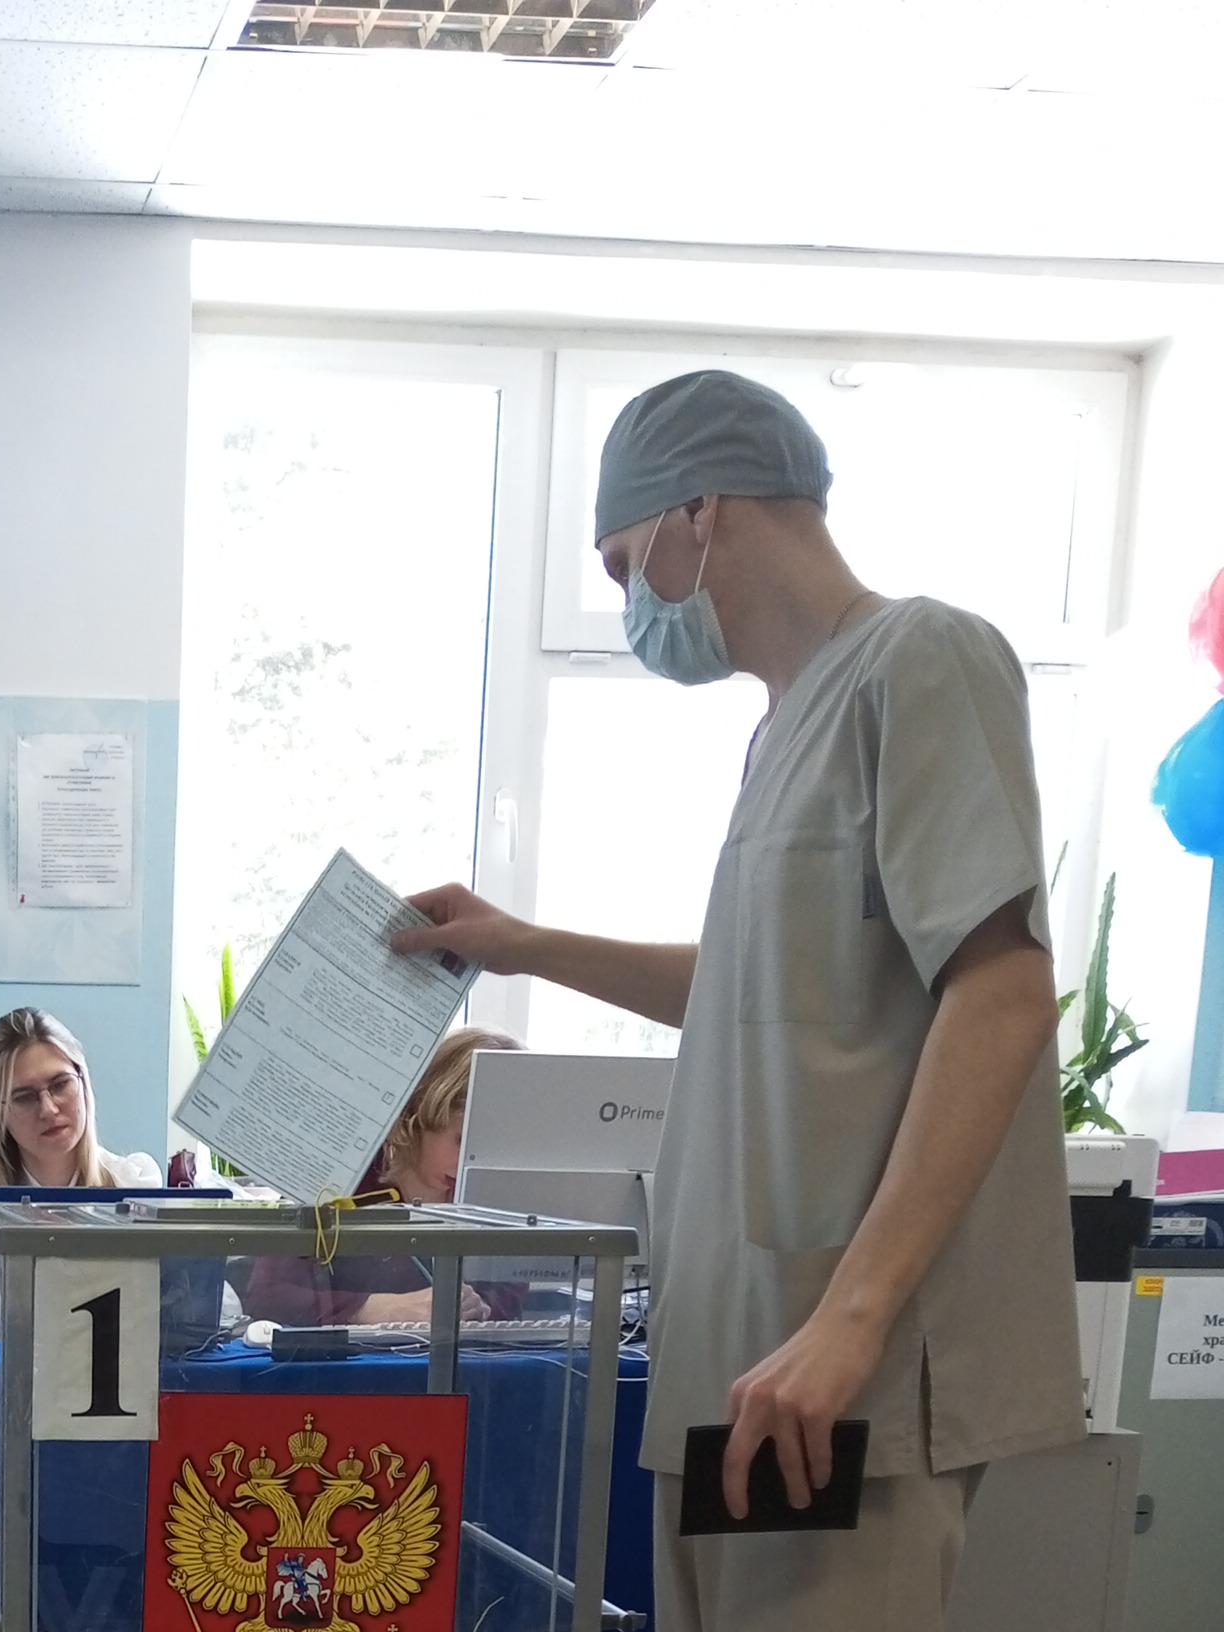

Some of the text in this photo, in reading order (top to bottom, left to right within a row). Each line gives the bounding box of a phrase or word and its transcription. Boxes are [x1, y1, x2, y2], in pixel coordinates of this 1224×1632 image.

[620, 1105, 666, 1120] Prime
[71, 1287, 137, 1417] 1
[1167, 1349, 1215, 1365] СЕЙФ
